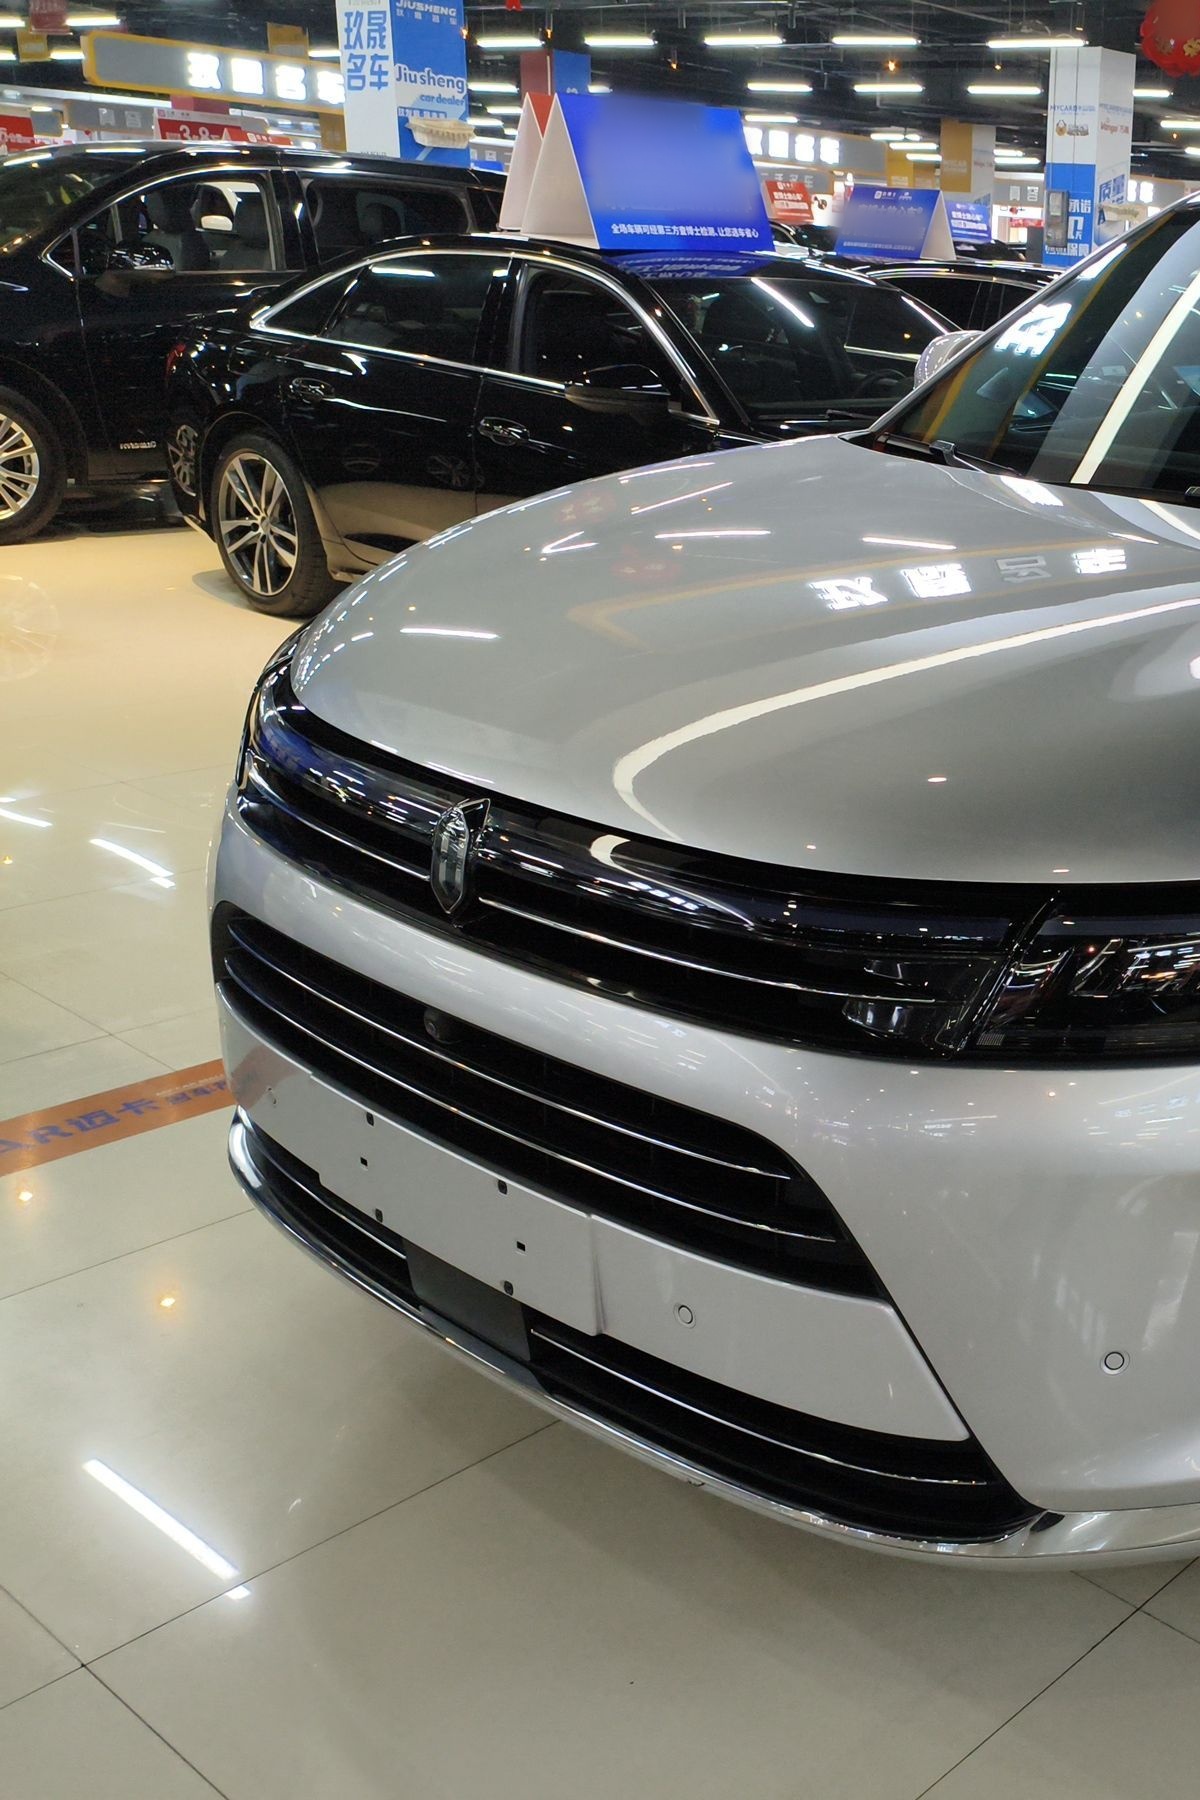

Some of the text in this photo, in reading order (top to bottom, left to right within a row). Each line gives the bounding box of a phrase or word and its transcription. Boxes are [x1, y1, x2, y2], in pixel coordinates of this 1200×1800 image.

[344, 10, 387, 50] 玖晟
[346, 53, 389, 91] 名车
[395, 65, 465, 94] Jiusheng
